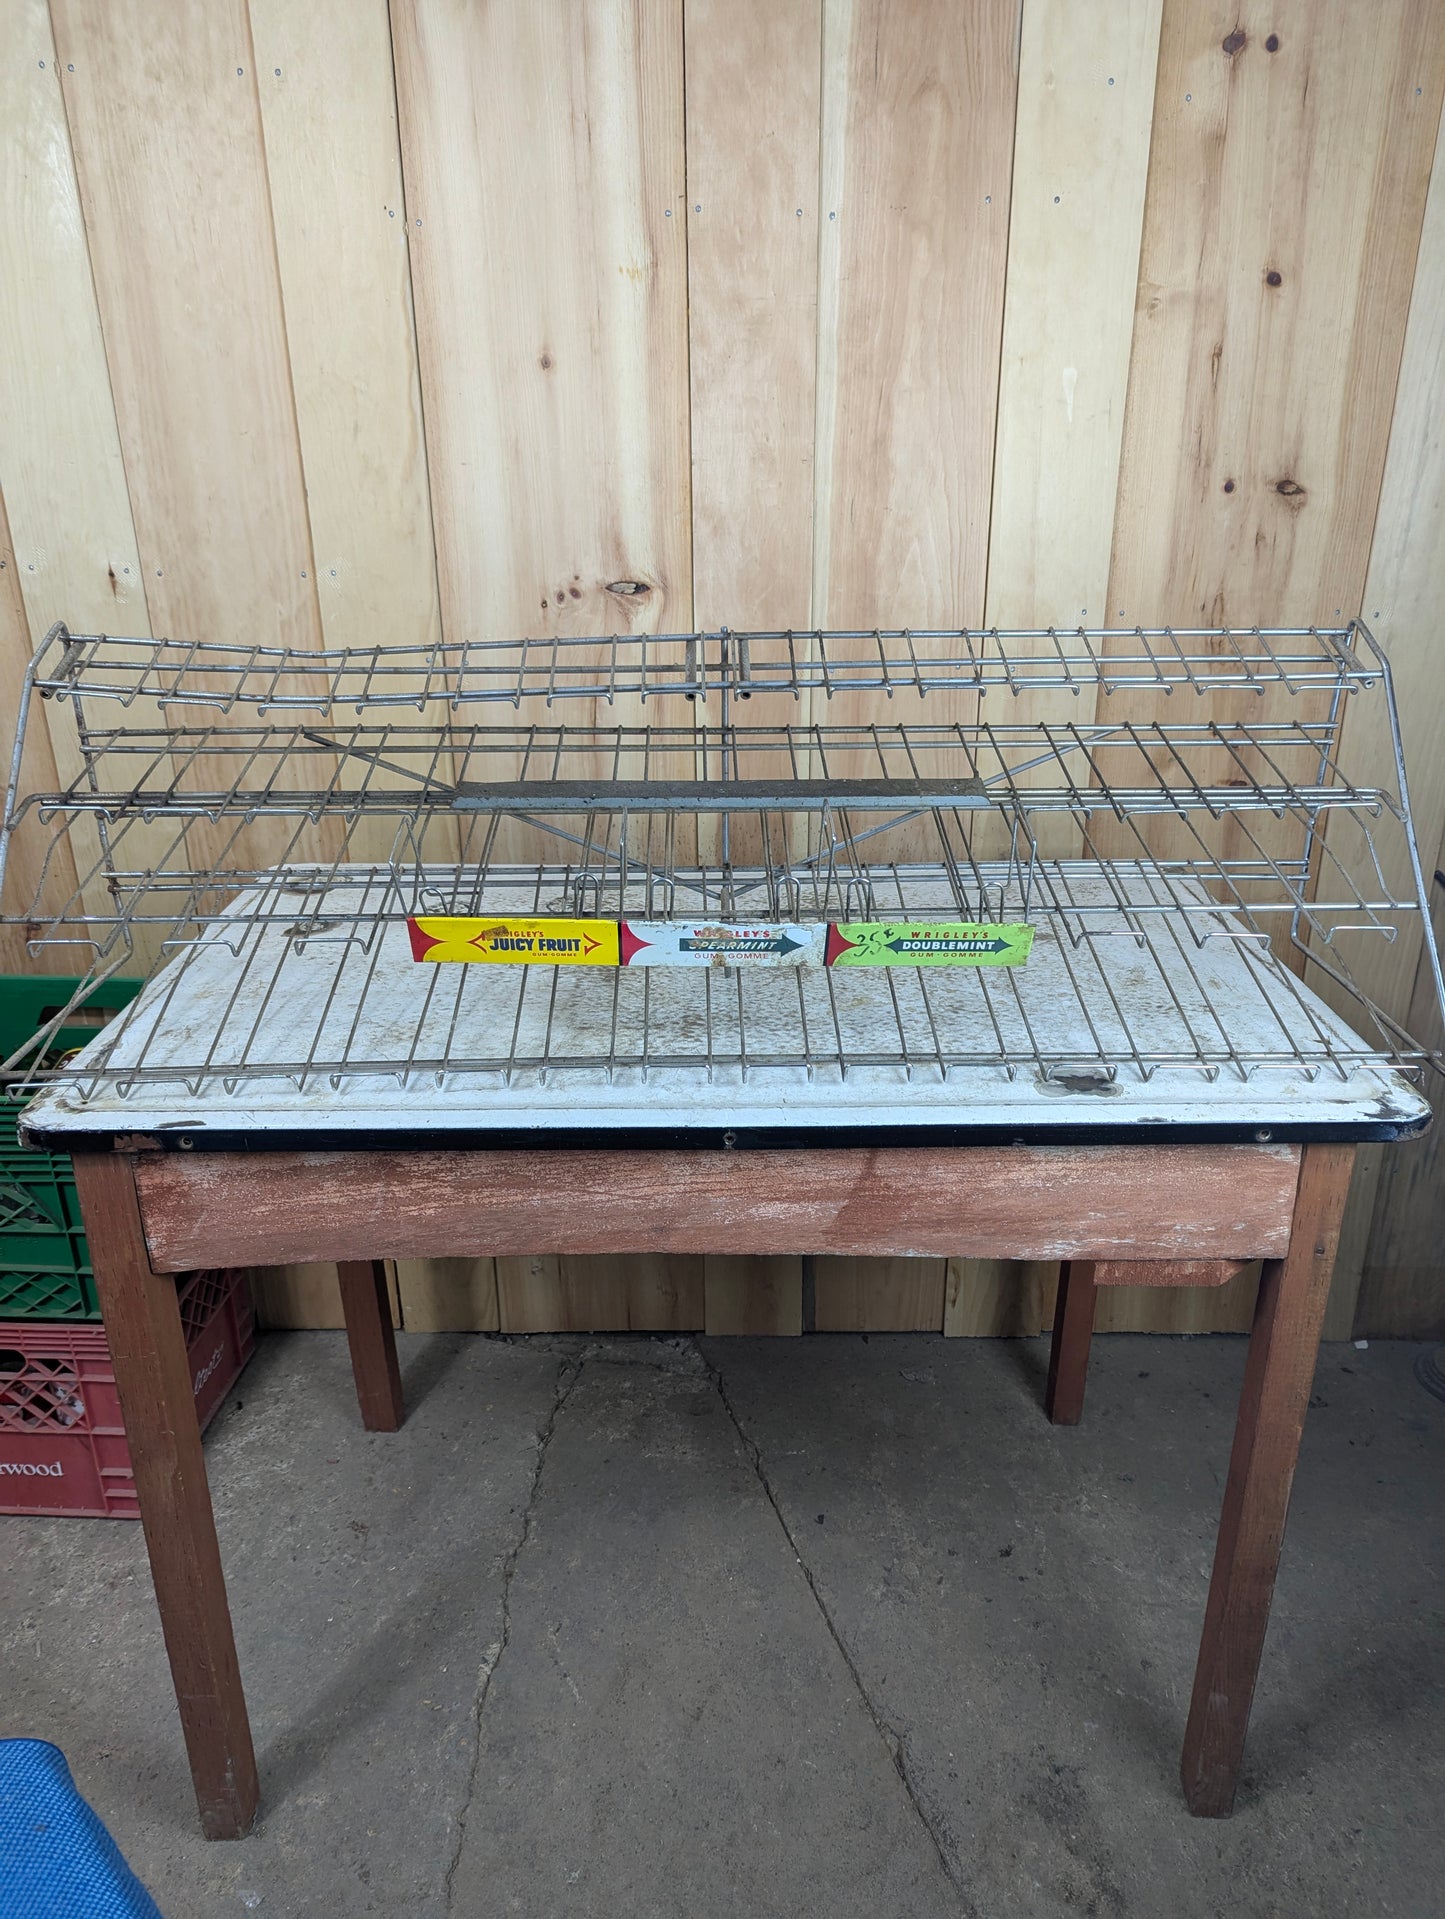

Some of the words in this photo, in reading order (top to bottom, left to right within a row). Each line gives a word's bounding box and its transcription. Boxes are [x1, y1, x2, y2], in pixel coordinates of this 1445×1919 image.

[495, 930, 544, 938] IGLEY'S
[693, 930, 770, 938] WLEY'S
[911, 931, 989, 939] WRIGLEY'S
[489, 937, 535, 951] JUICY
[538, 938, 581, 952] FRUIT
[902, 941, 995, 950] DOUBLEMINT
